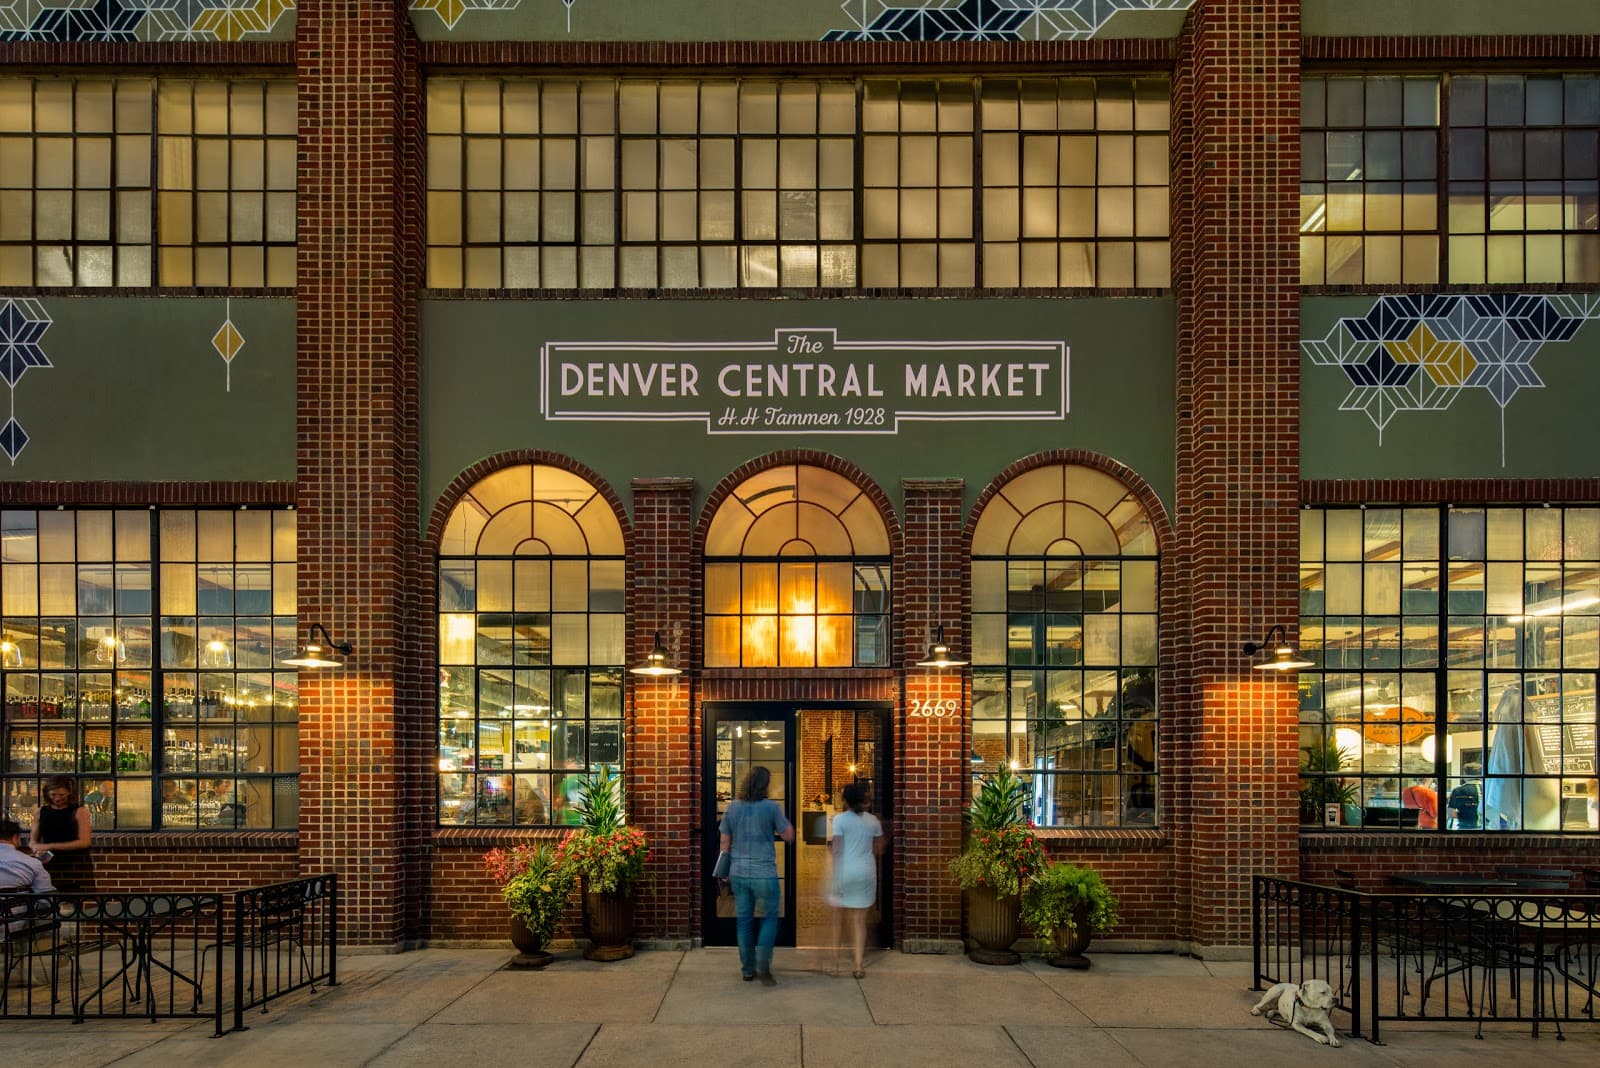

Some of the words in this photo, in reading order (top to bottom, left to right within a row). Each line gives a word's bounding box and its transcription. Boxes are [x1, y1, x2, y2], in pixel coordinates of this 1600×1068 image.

[788, 335, 824, 354] The
[561, 363, 700, 396] DENVER
[717, 363, 884, 397] CENTRAL
[905, 364, 1050, 396] MARKET
[764, 407, 841, 426] Tammen
[845, 408, 886, 425] 1928
[910, 700, 957, 717] 2669
